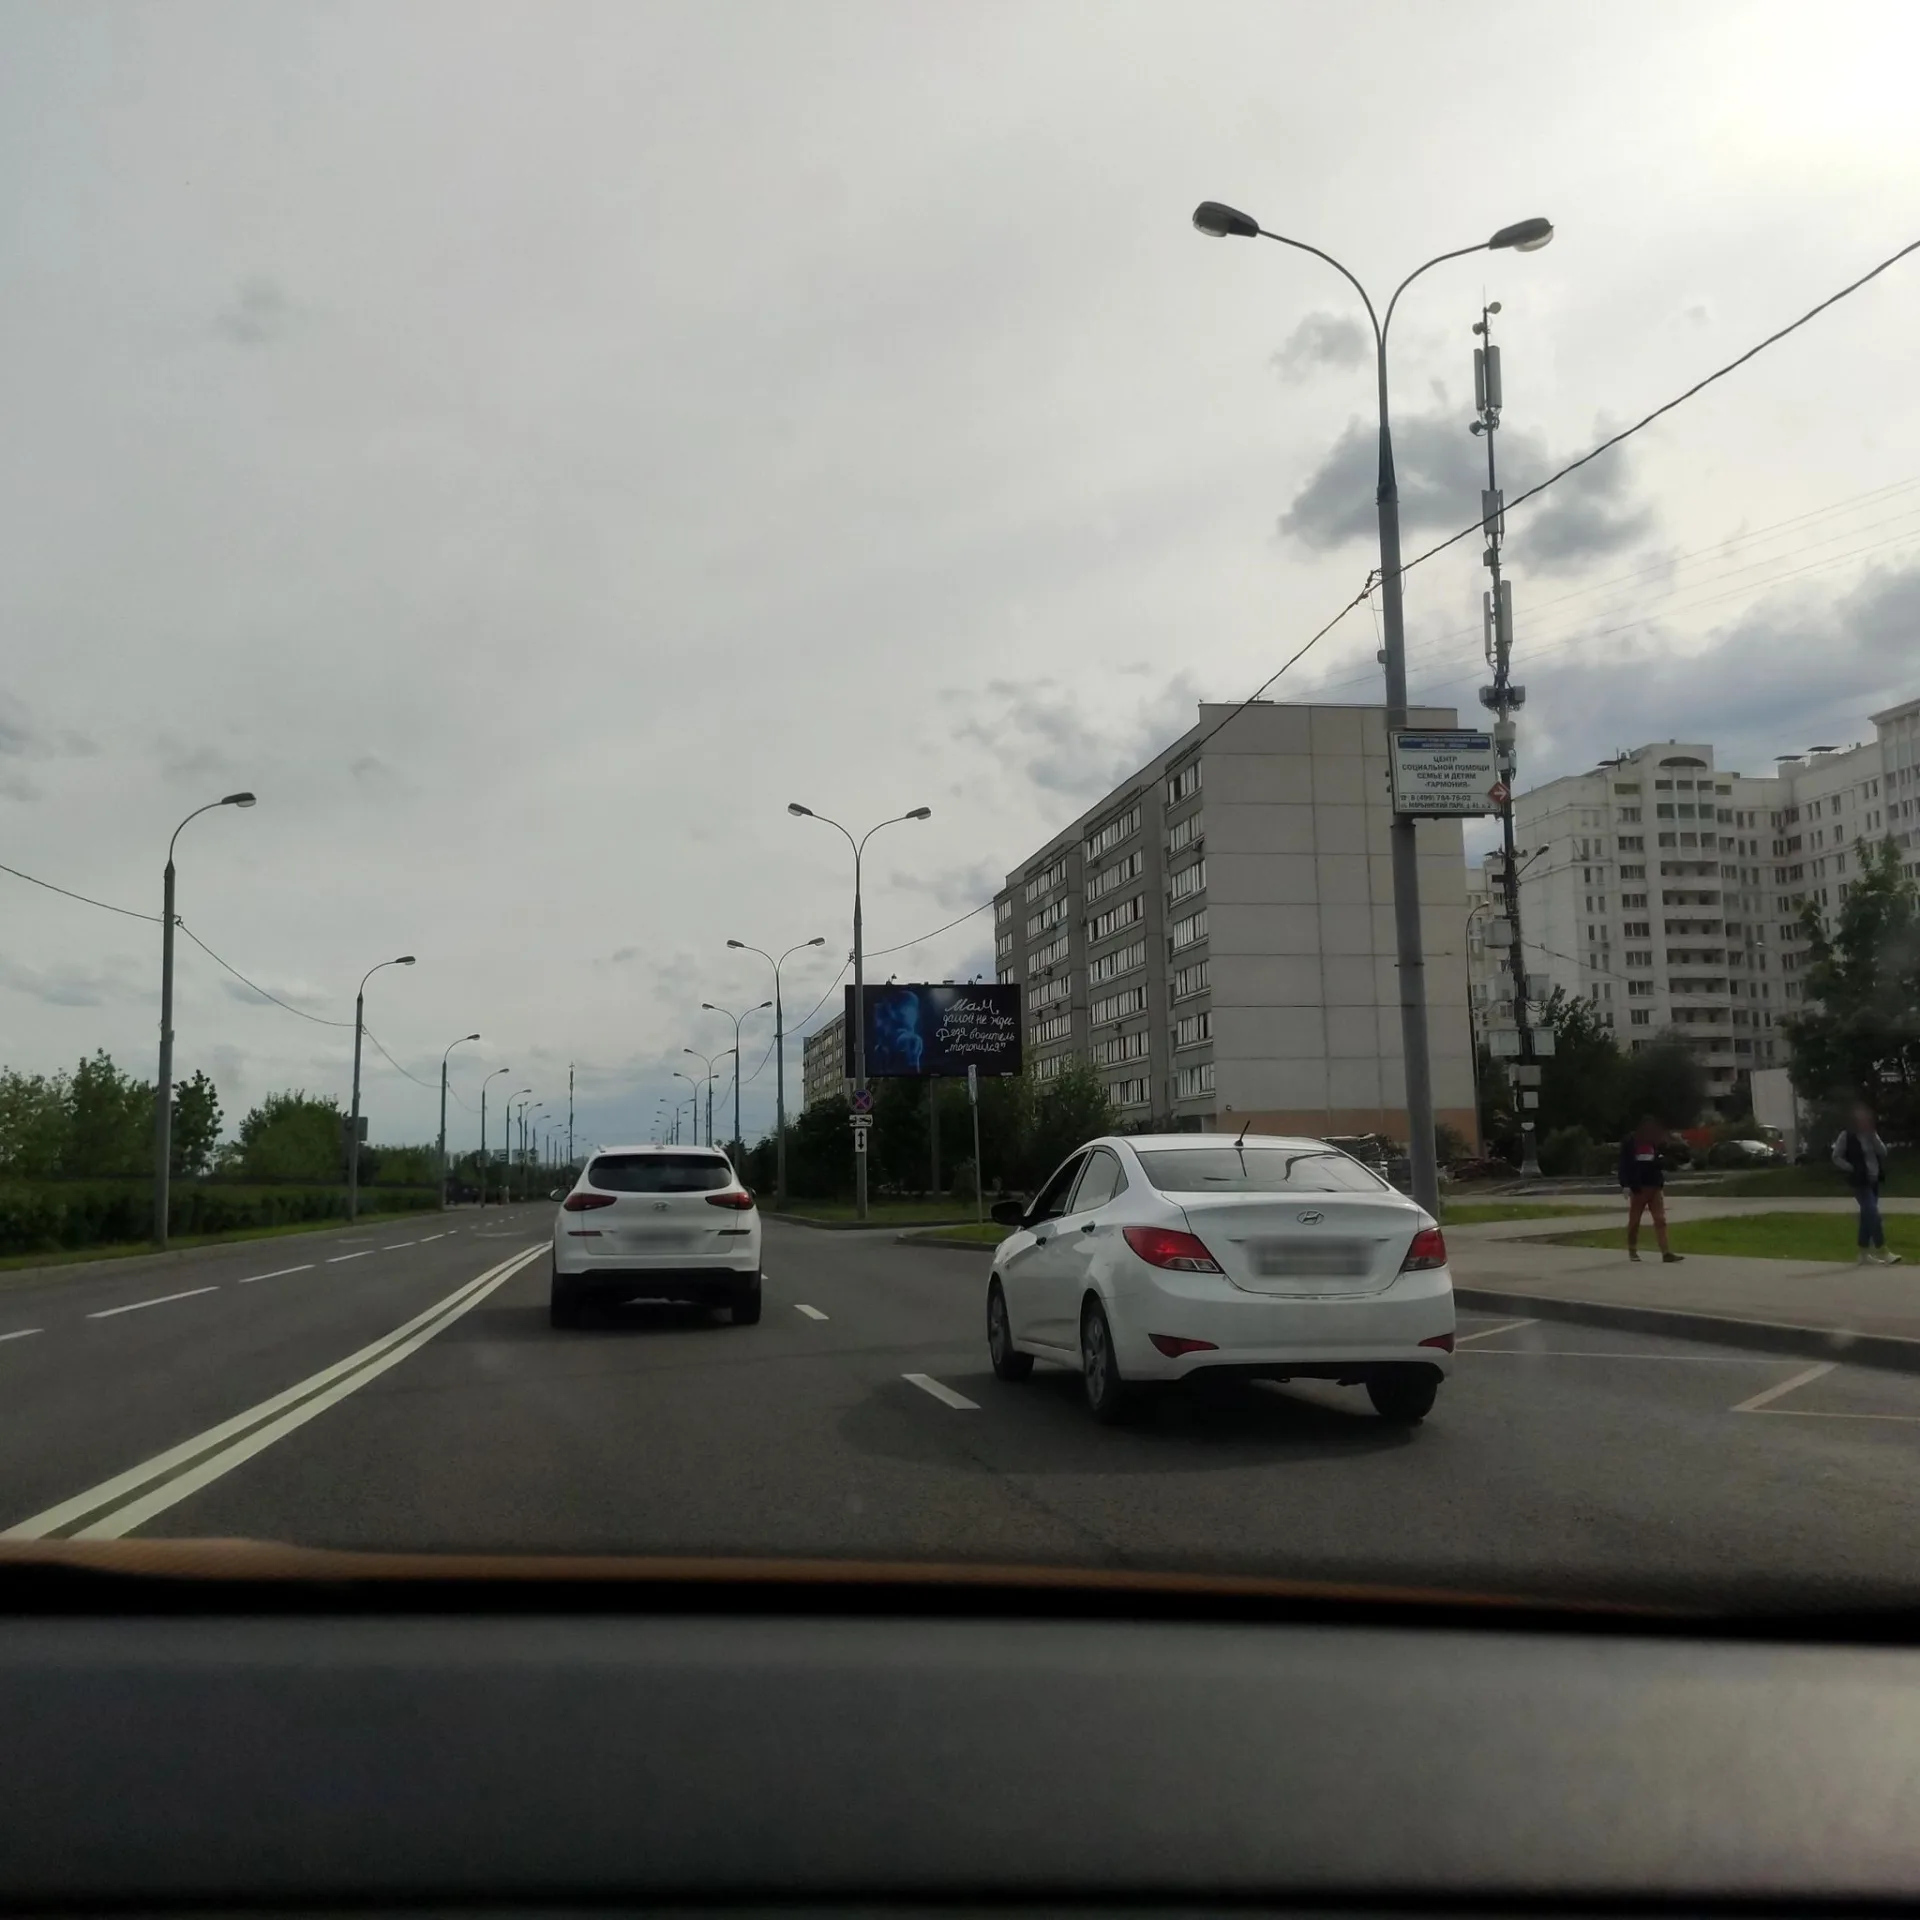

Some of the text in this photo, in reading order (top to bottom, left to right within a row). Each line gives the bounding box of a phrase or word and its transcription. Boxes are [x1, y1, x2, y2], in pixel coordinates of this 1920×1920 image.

[1402, 763, 1490, 772] СОЦИАЛЬНОЙ ПОМОЩИ
[1417, 772, 1442, 780] СЕМЬЕ
[976, 1015, 987, 1025] не
[969, 1027, 1015, 1043] водитель
